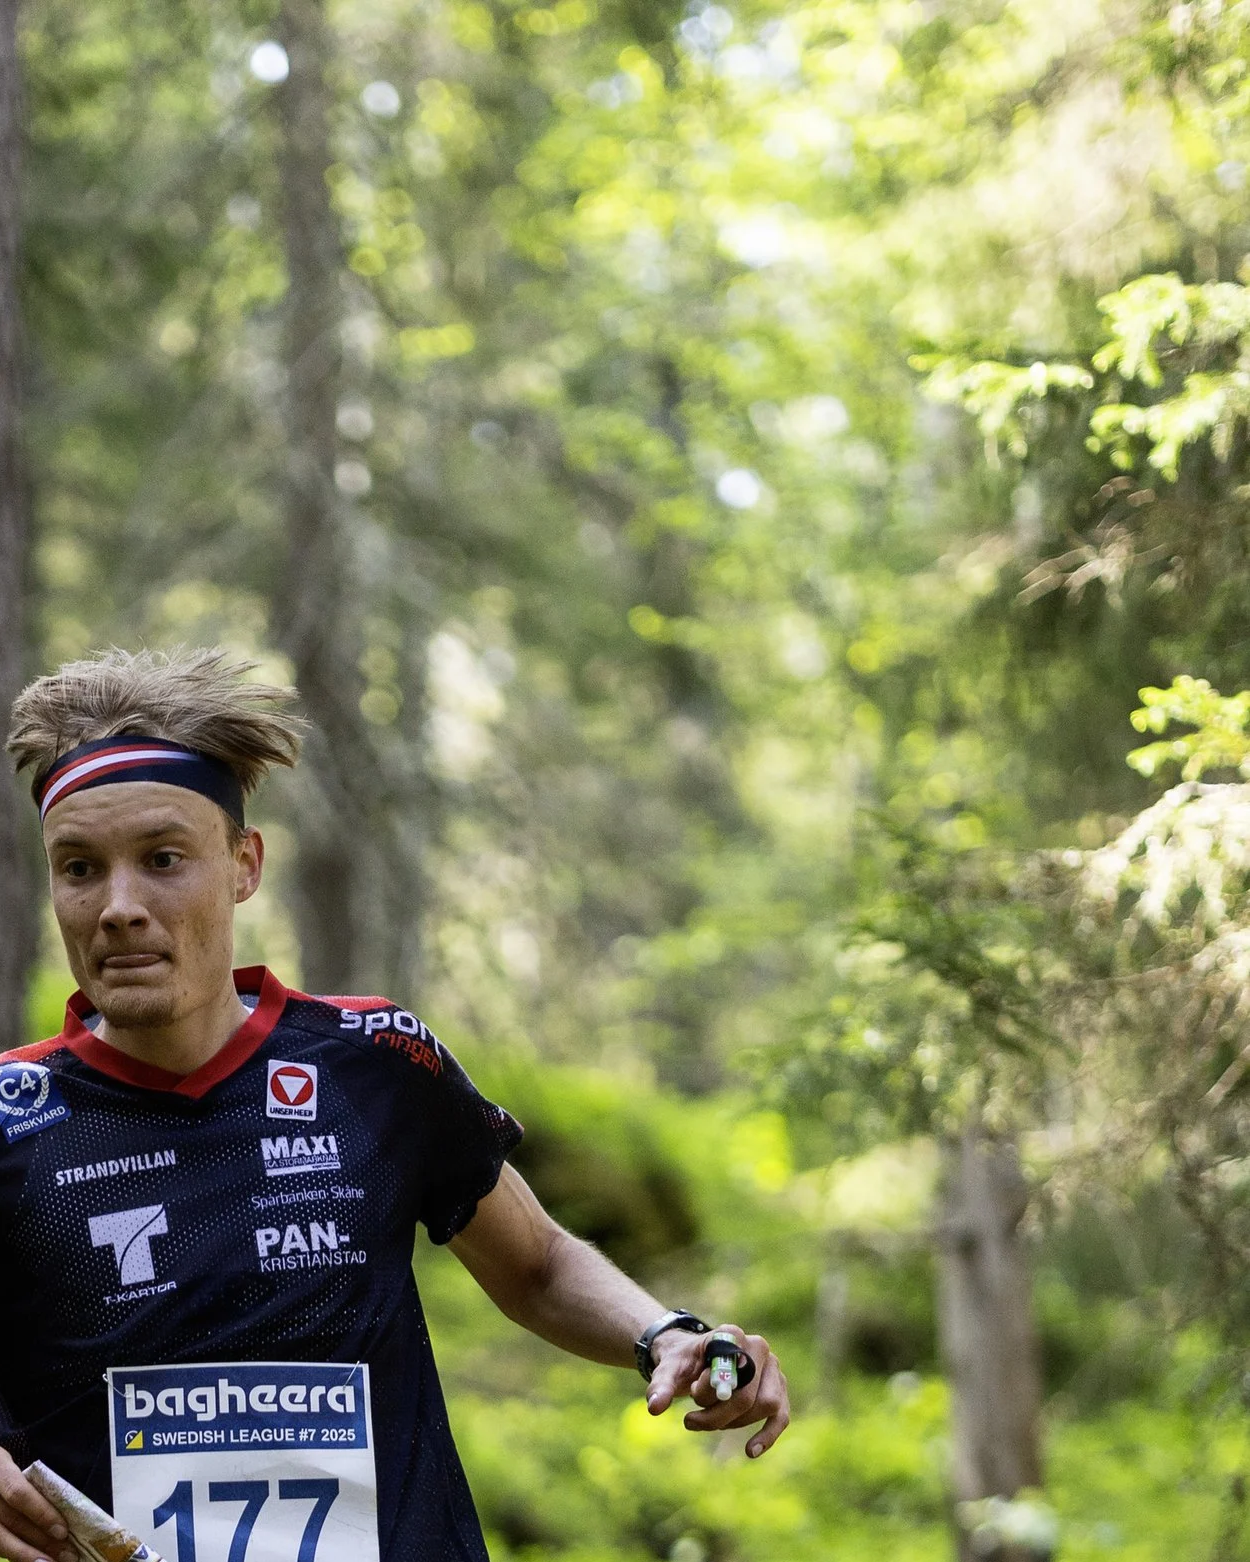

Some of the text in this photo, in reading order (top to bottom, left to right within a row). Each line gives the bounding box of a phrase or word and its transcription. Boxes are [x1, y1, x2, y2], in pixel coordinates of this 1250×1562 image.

[0, 1071, 36, 1100] C4
[270, 1107, 313, 1117] UNSER HEER
[260, 1135, 339, 1161] MAXI
[55, 1149, 177, 1187] STRANDVILLAN
[251, 1184, 365, 1211] Sparbanken Skåne
[255, 1220, 350, 1257] PAN-
[260, 1250, 367, 1273] KRISTIANSTAD
[103, 1280, 177, 1305] T-KARTOR
[125, 1378, 356, 1422] bagheera
[152, 1427, 356, 1448] SWEDISH LEAGUE #7 2025
